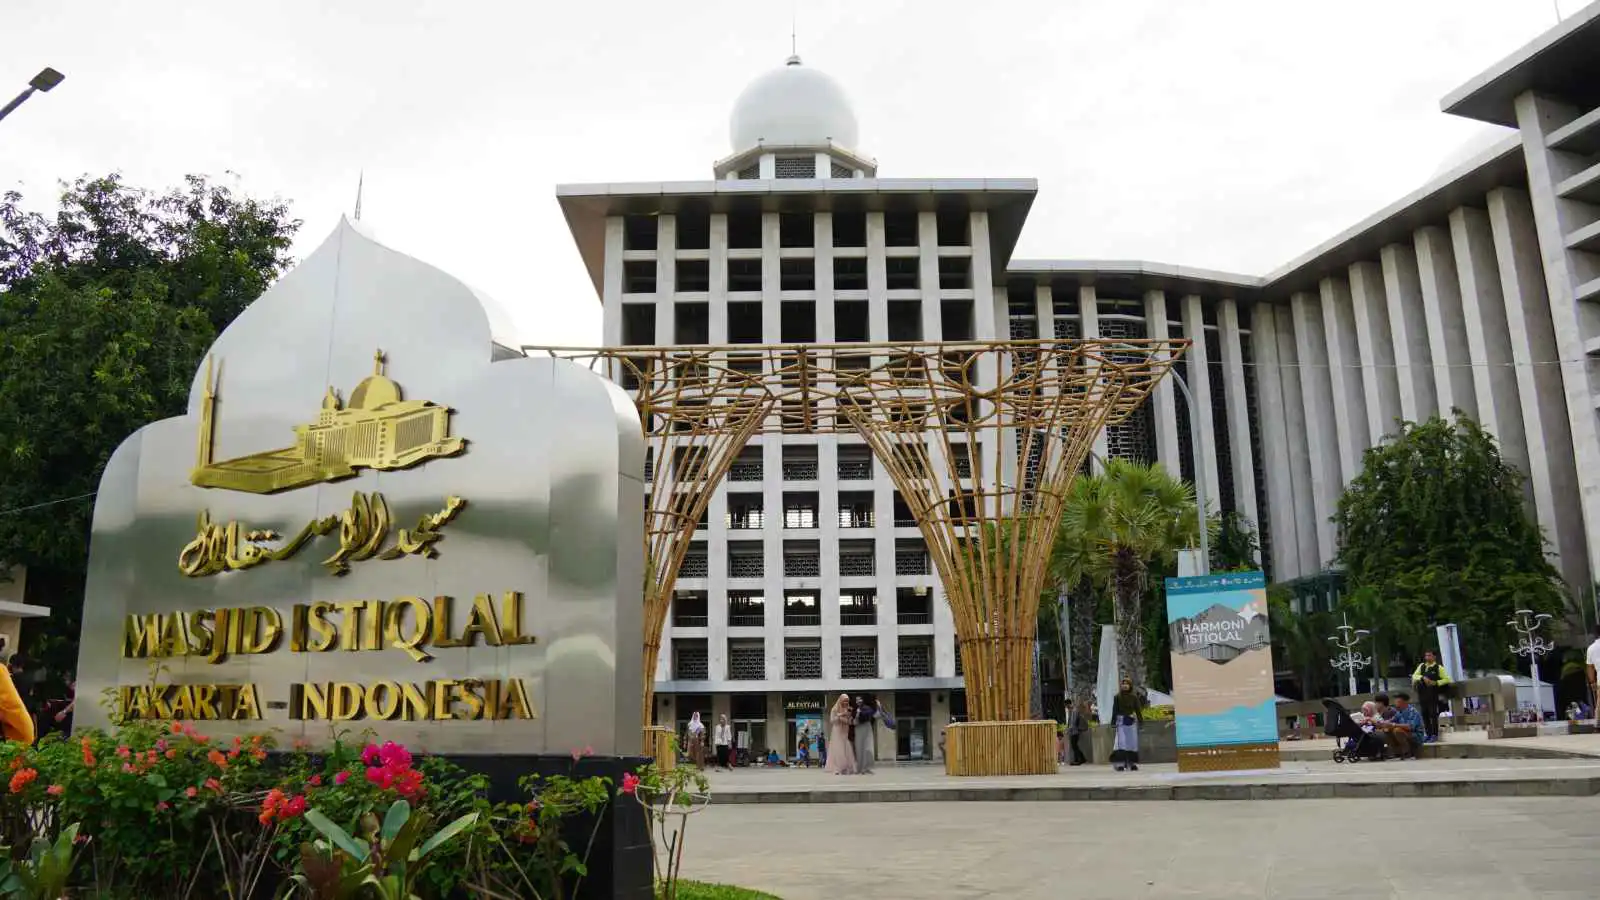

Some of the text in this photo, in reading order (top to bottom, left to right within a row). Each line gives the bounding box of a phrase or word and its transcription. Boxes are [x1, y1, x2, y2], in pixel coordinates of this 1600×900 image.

[124, 592, 536, 664] MASJID ISTIQLAL
[1182, 619, 1244, 634] HARMONI
[119, 683, 263, 720] JAKARTA
[289, 677, 537, 721] INDONESIA
